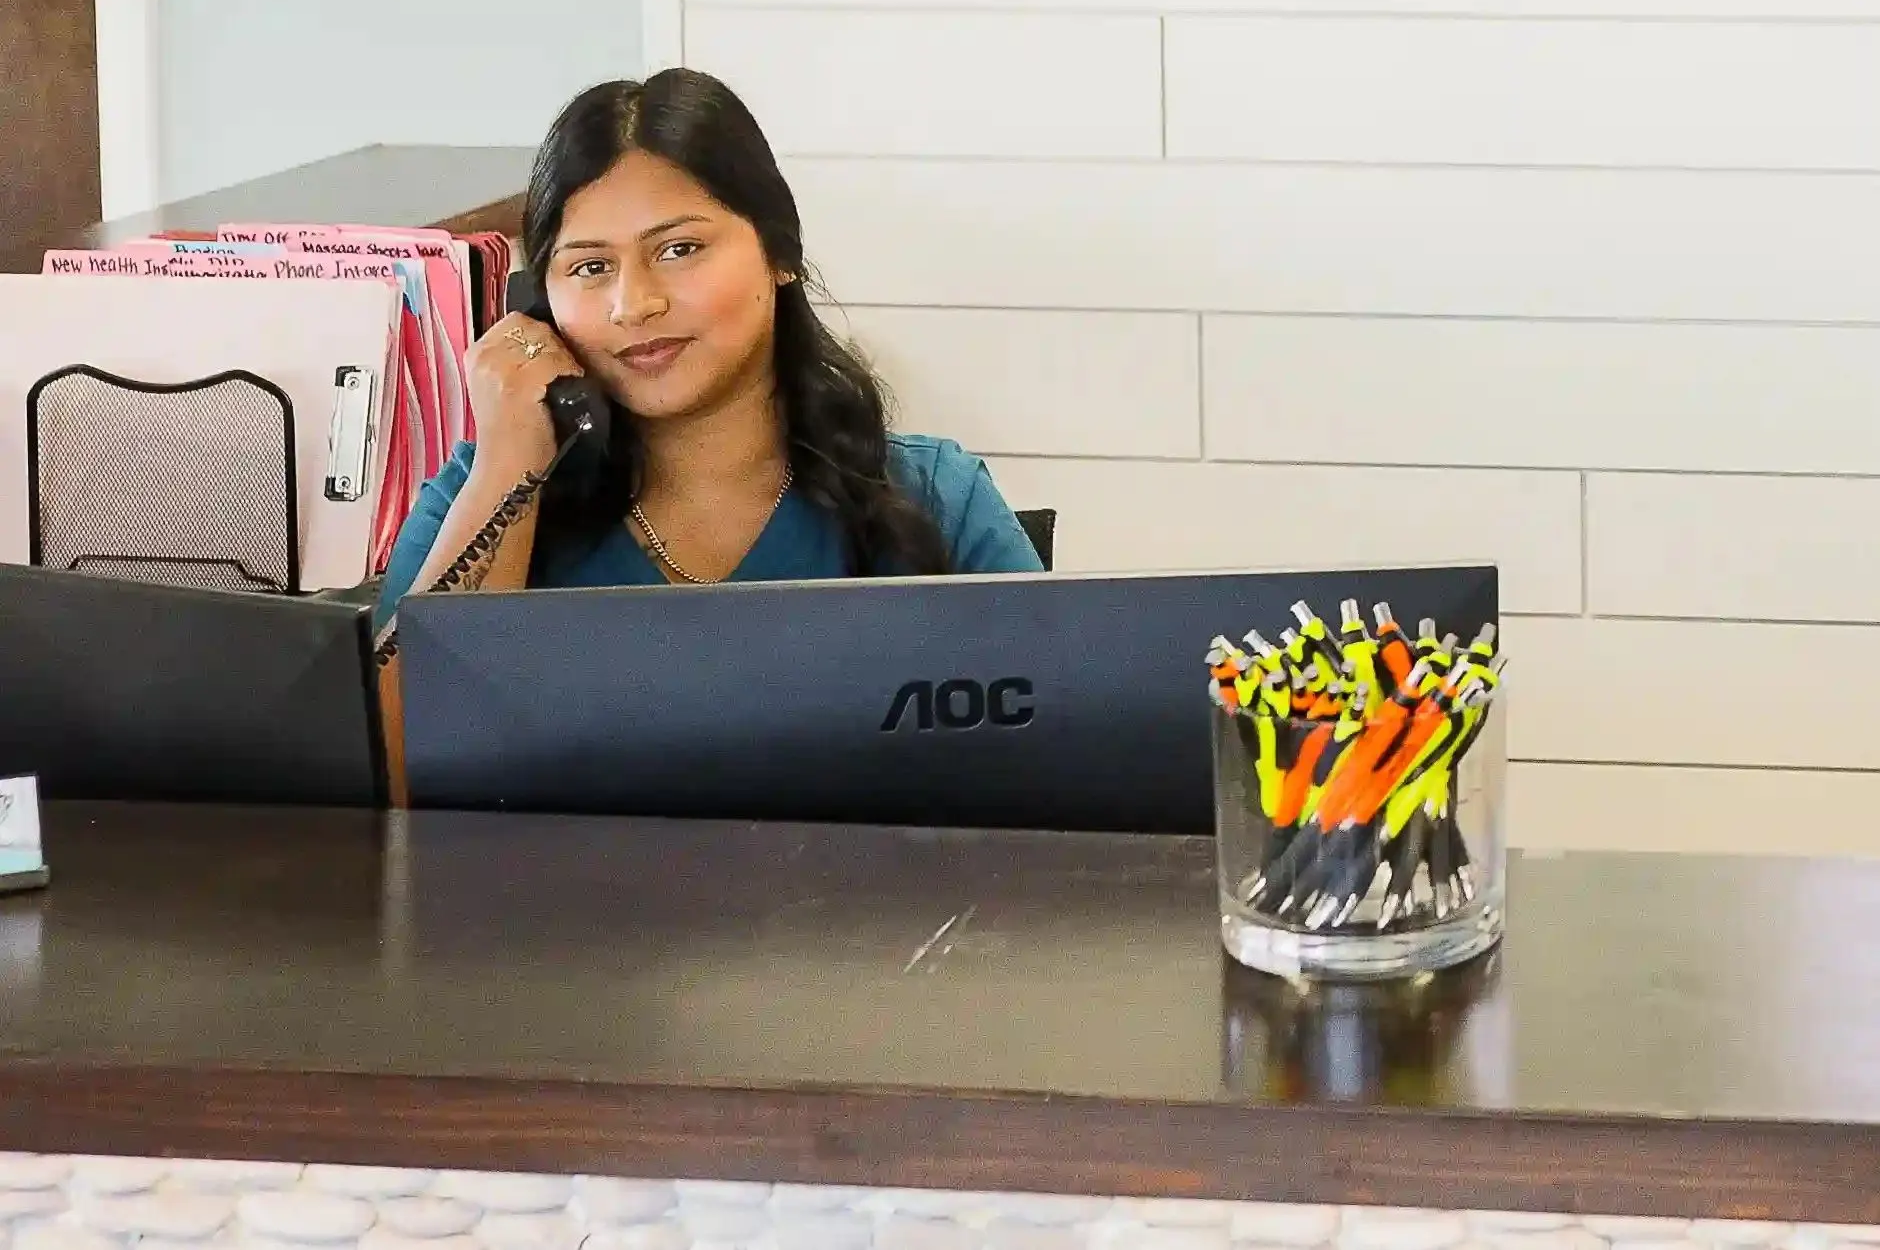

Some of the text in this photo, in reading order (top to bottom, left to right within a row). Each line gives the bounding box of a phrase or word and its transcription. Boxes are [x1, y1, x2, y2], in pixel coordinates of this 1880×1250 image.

[51, 257, 83, 274] New
[88, 255, 138, 275] health
[274, 260, 392, 279] Phone Intake
[880, 677, 1036, 733] AOC
